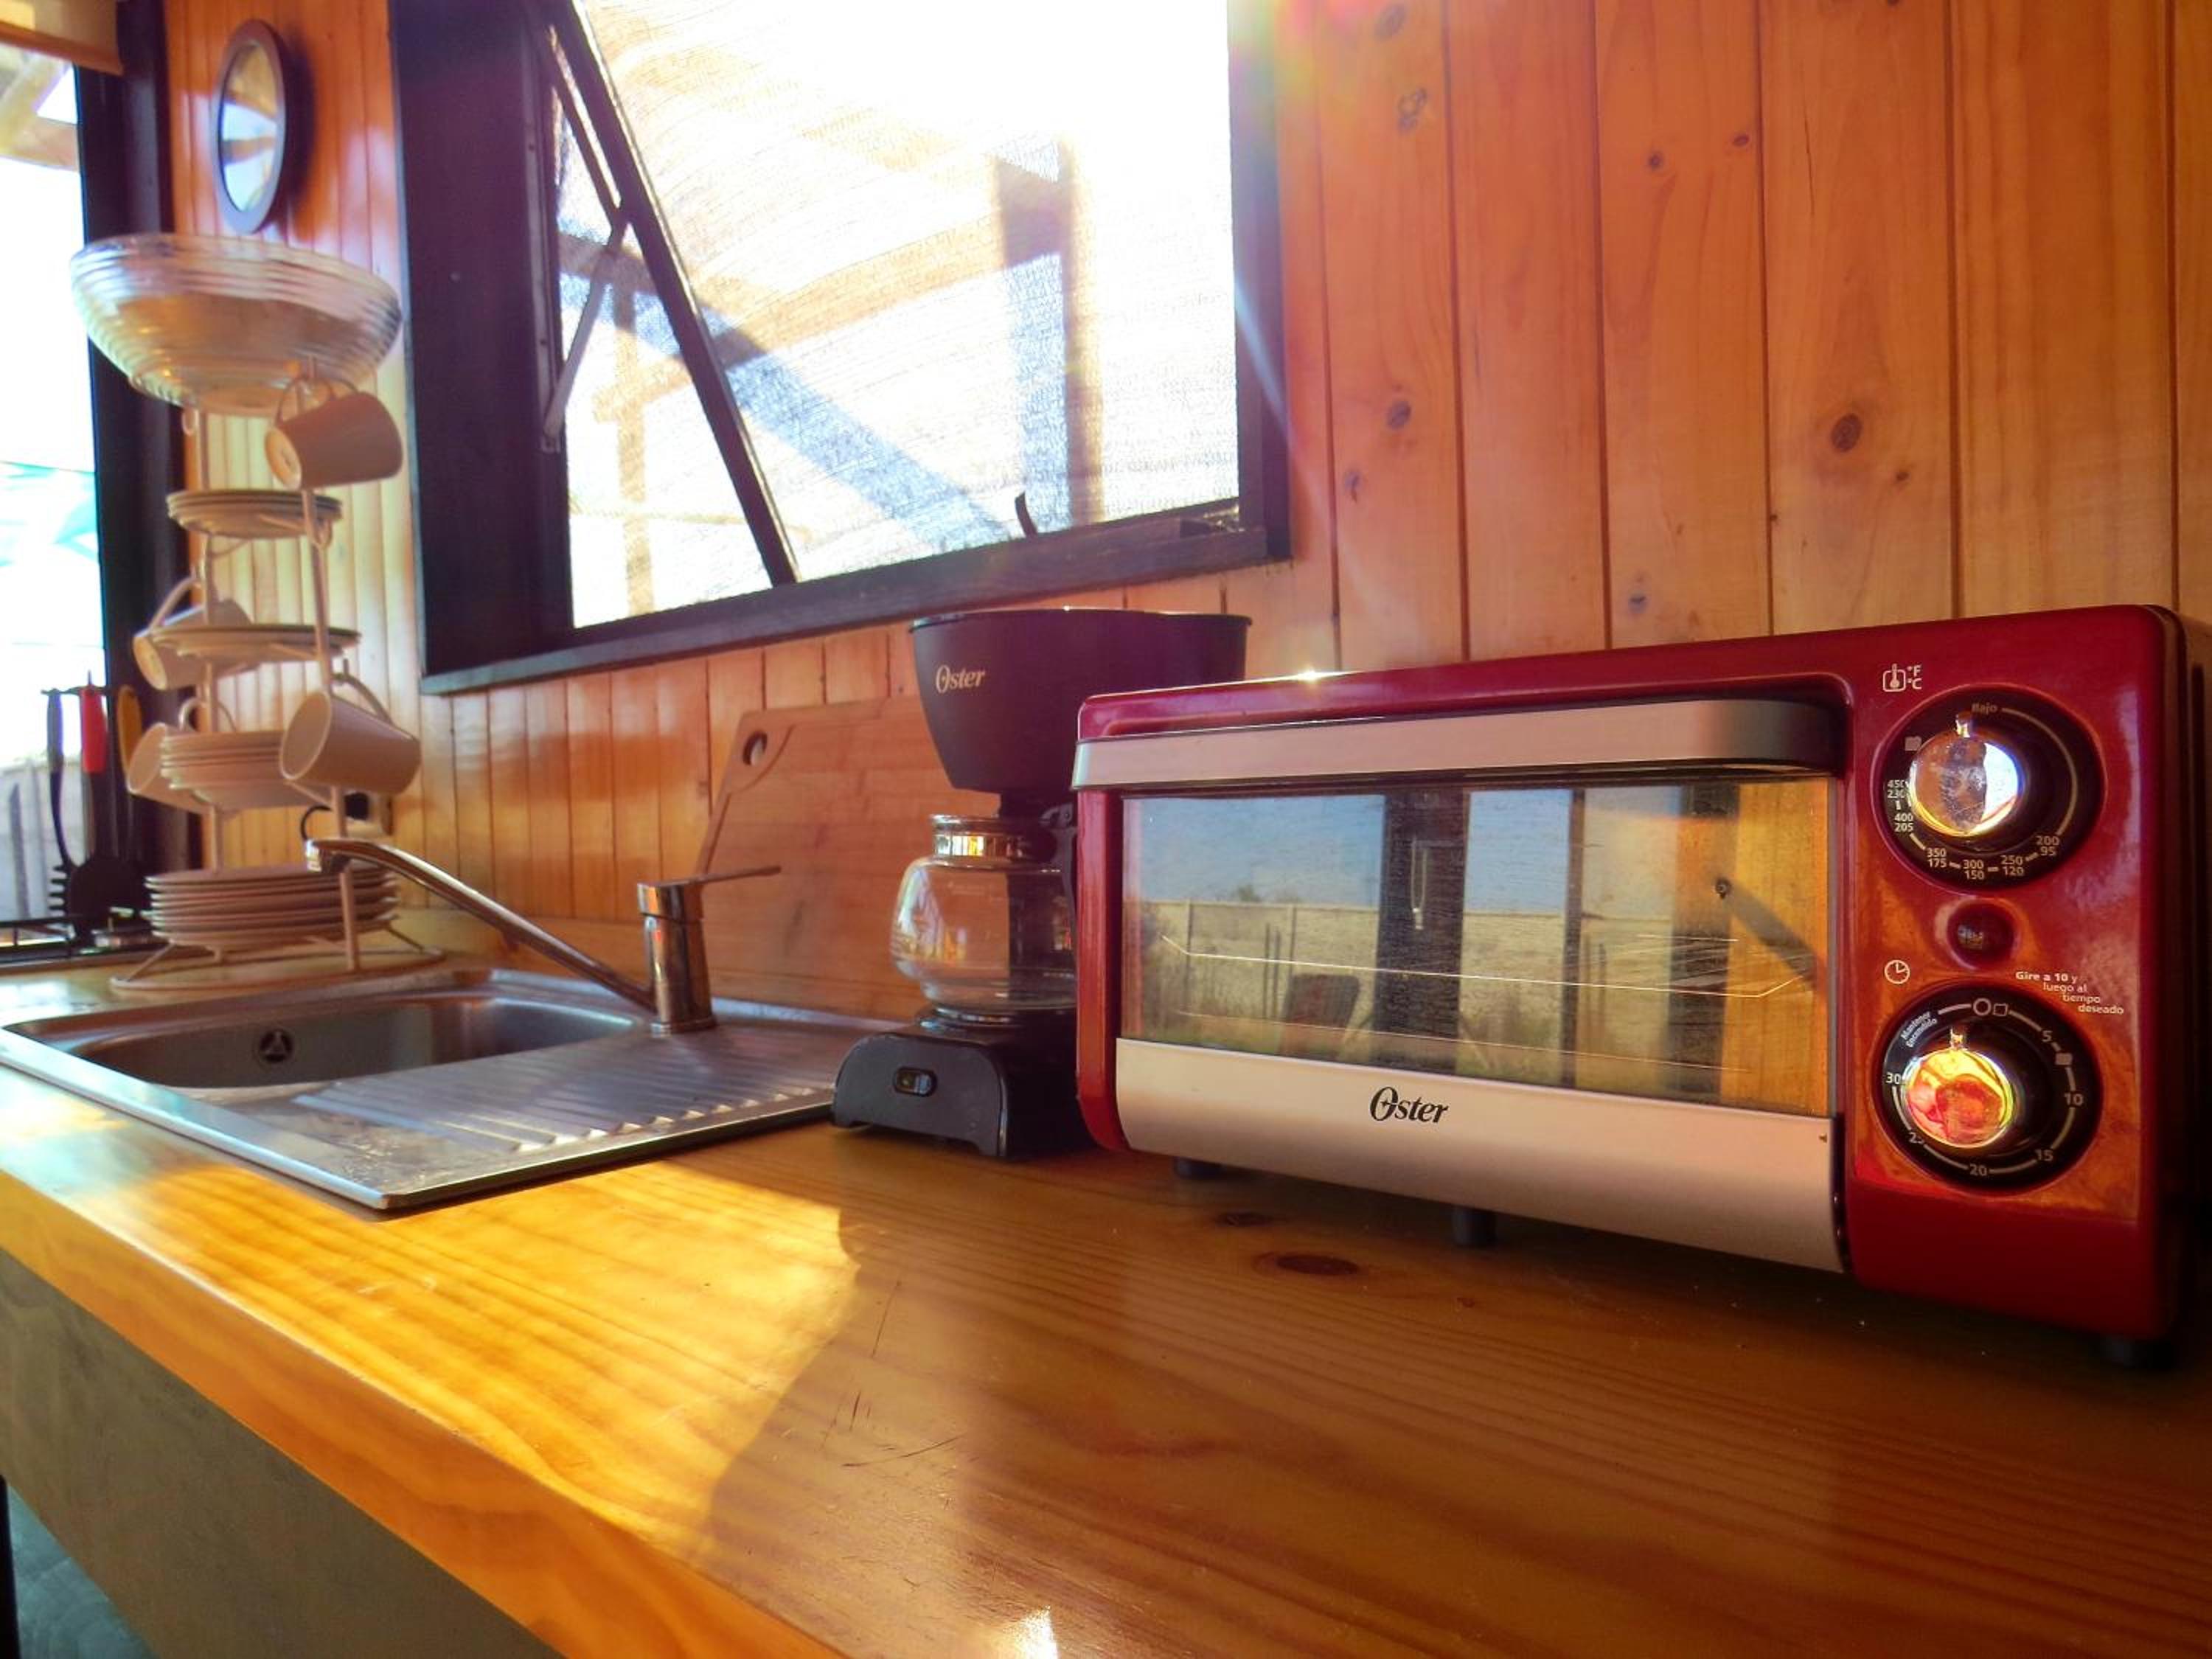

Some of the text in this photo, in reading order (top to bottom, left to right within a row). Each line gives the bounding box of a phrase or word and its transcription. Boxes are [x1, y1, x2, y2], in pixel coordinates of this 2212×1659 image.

[936, 664, 986, 694] Oster
[1972, 702, 1997, 715] Bajo
[1894, 813, 1913, 822] 400
[1894, 822, 1913, 832] 205
[2037, 835, 2059, 846] 200
[1927, 847, 1947, 858] 350
[2039, 846, 2056, 856] 95
[1927, 858, 1947, 868] 175
[1963, 859, 1984, 869] 300
[2000, 855, 2023, 866] 250
[1964, 870, 1984, 880] 150
[2003, 866, 2025, 876] 120
[2015, 971, 2078, 984] Gire a 10 y
[2042, 981, 2087, 993] luego al
[2062, 992, 2101, 1004] tiempo
[2077, 1004, 2124, 1015] deseado
[2042, 1031, 2053, 1043] 5
[1885, 1071, 1902, 1085] 30
[1369, 1086, 1449, 1123] Oster
[2065, 1093, 2084, 1106] 10
[2037, 1149, 2053, 1162] 15
[1969, 1164, 1987, 1176] 20
